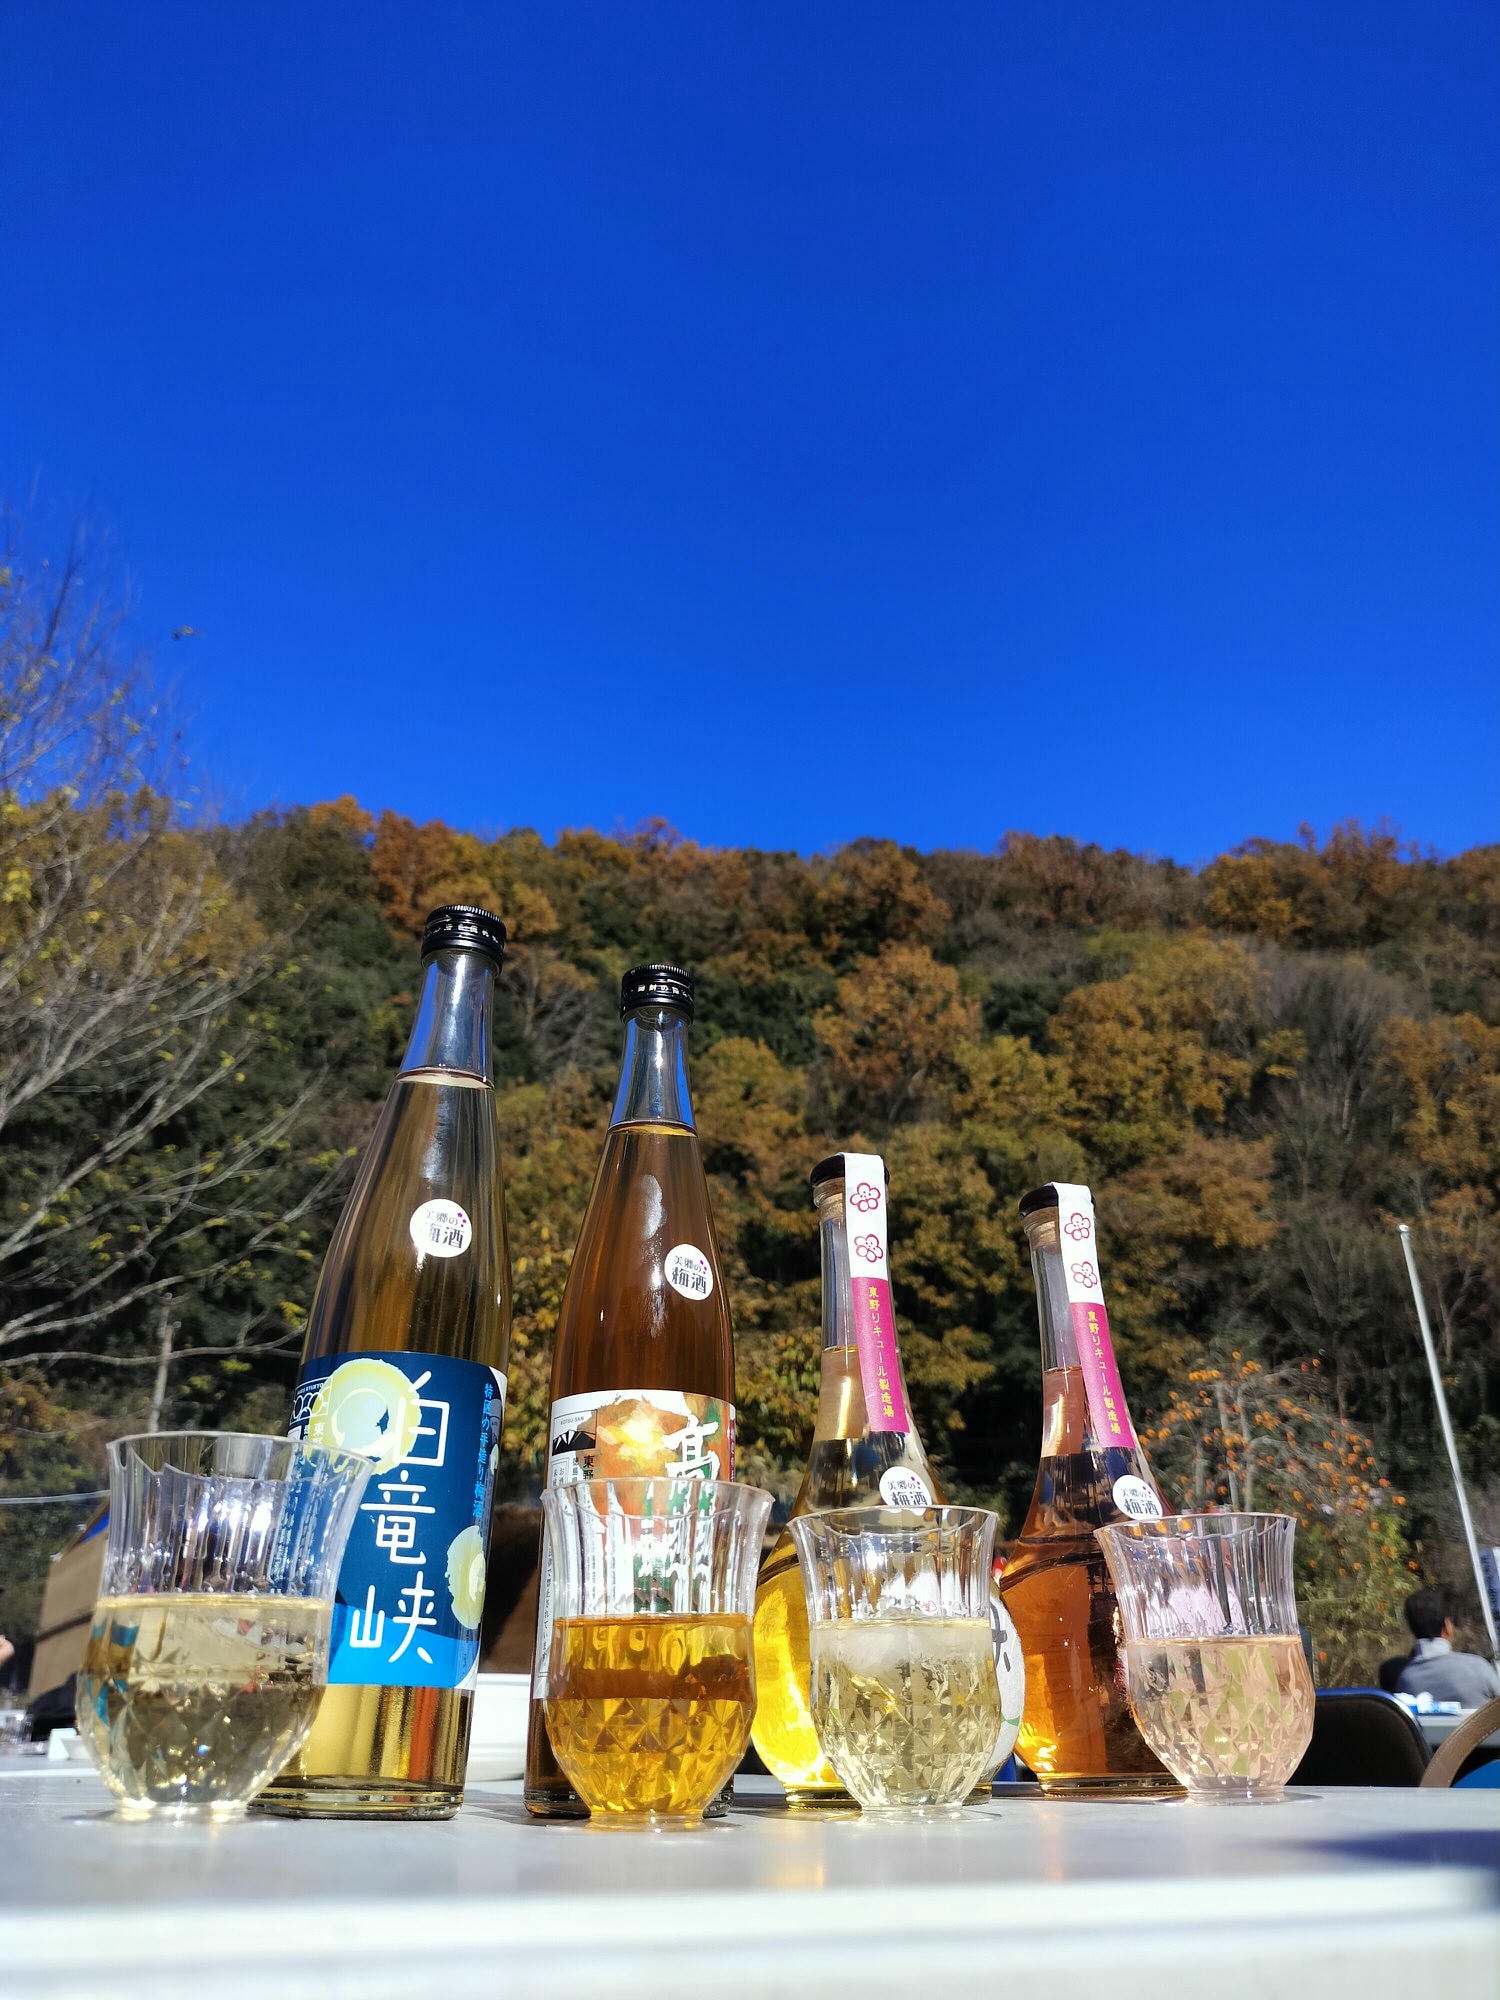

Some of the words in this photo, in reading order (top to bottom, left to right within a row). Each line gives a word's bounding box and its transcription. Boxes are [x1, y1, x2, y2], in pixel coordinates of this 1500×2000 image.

[671, 1266, 707, 1295] 梅酒
[868, 1286, 895, 1418] 東野リキュール製造場
[1088, 1311, 1121, 1435] 東野リキュール製造場
[349, 1370, 450, 1665] 白竜峡
[1123, 1498, 1160, 1516] 梅酒
